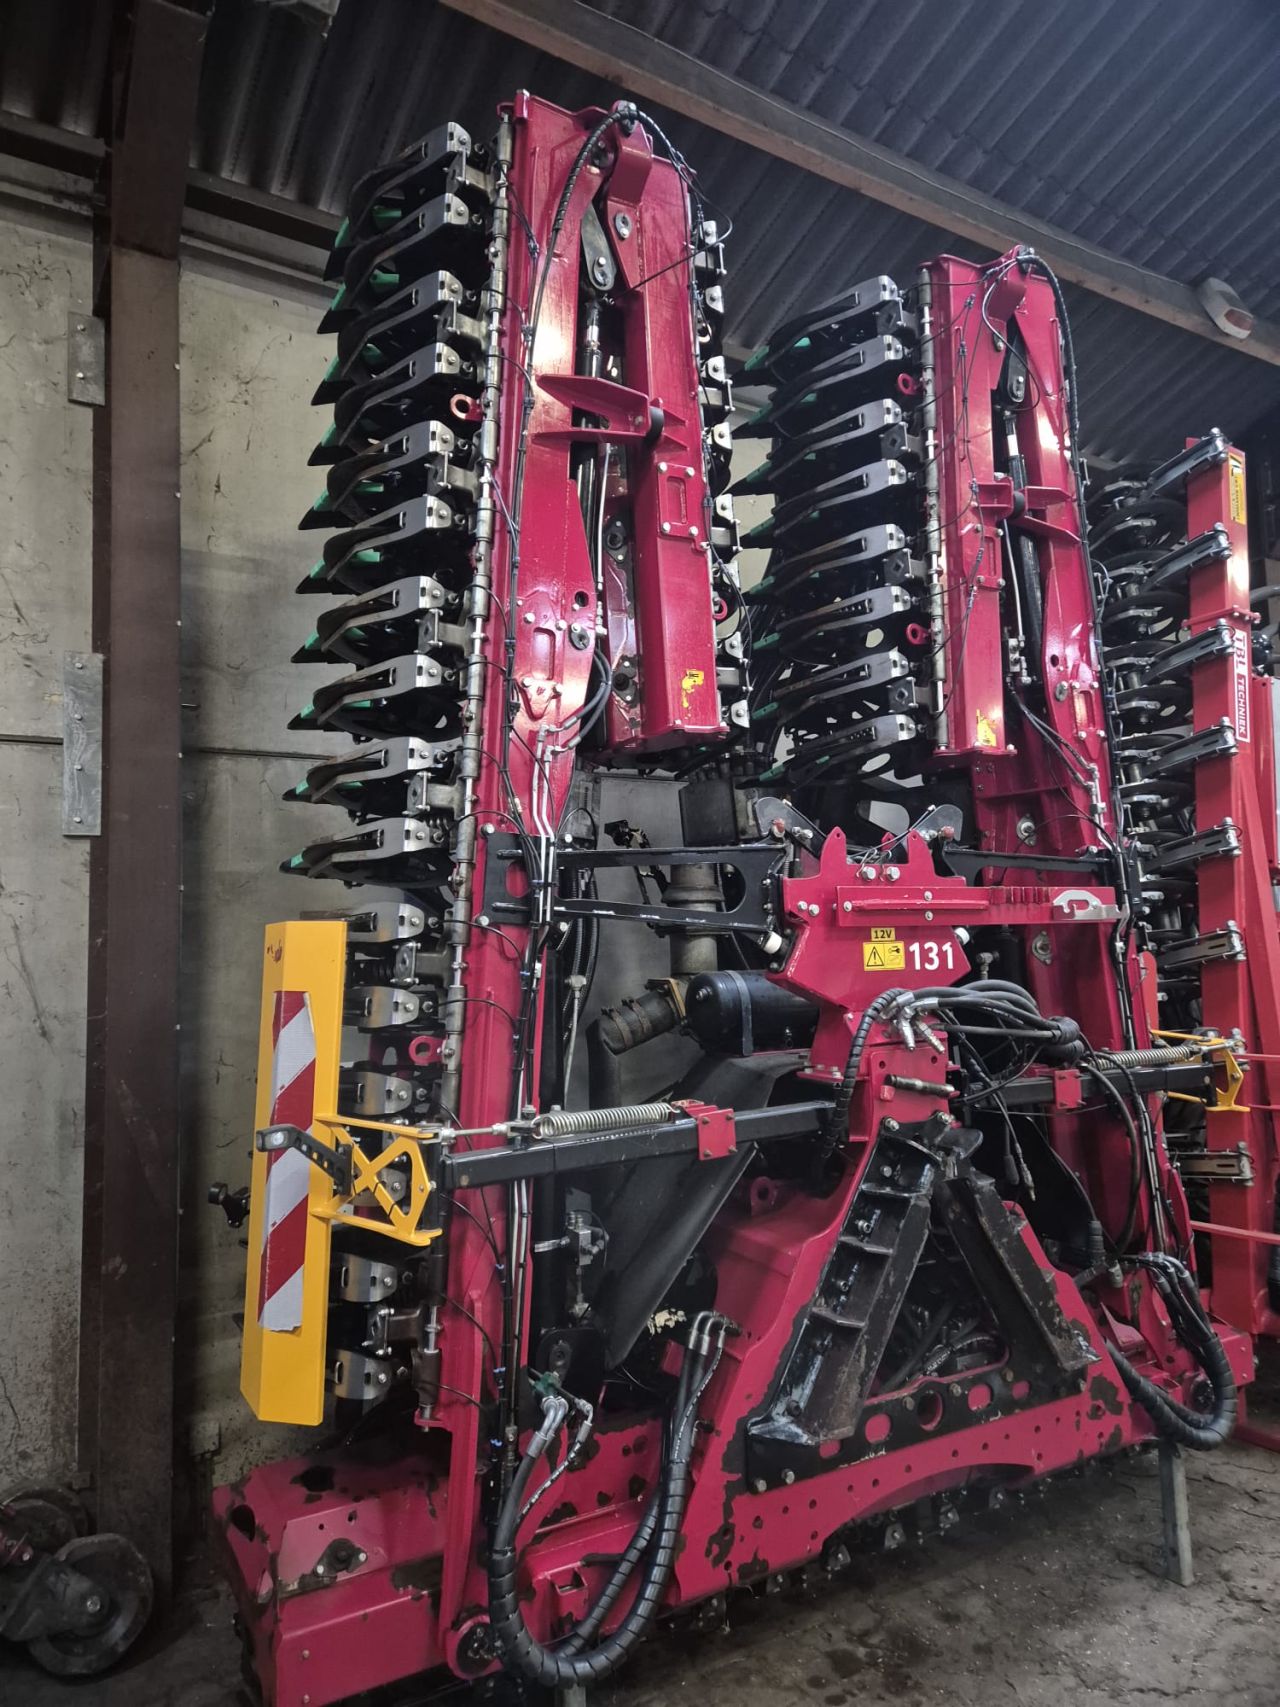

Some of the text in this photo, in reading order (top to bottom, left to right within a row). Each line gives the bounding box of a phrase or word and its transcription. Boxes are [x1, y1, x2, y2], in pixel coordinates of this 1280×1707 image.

[1235, 635, 1246, 735] TBL TECHNIEK
[874, 929, 892, 939] 12V
[909, 941, 954, 970] 131
